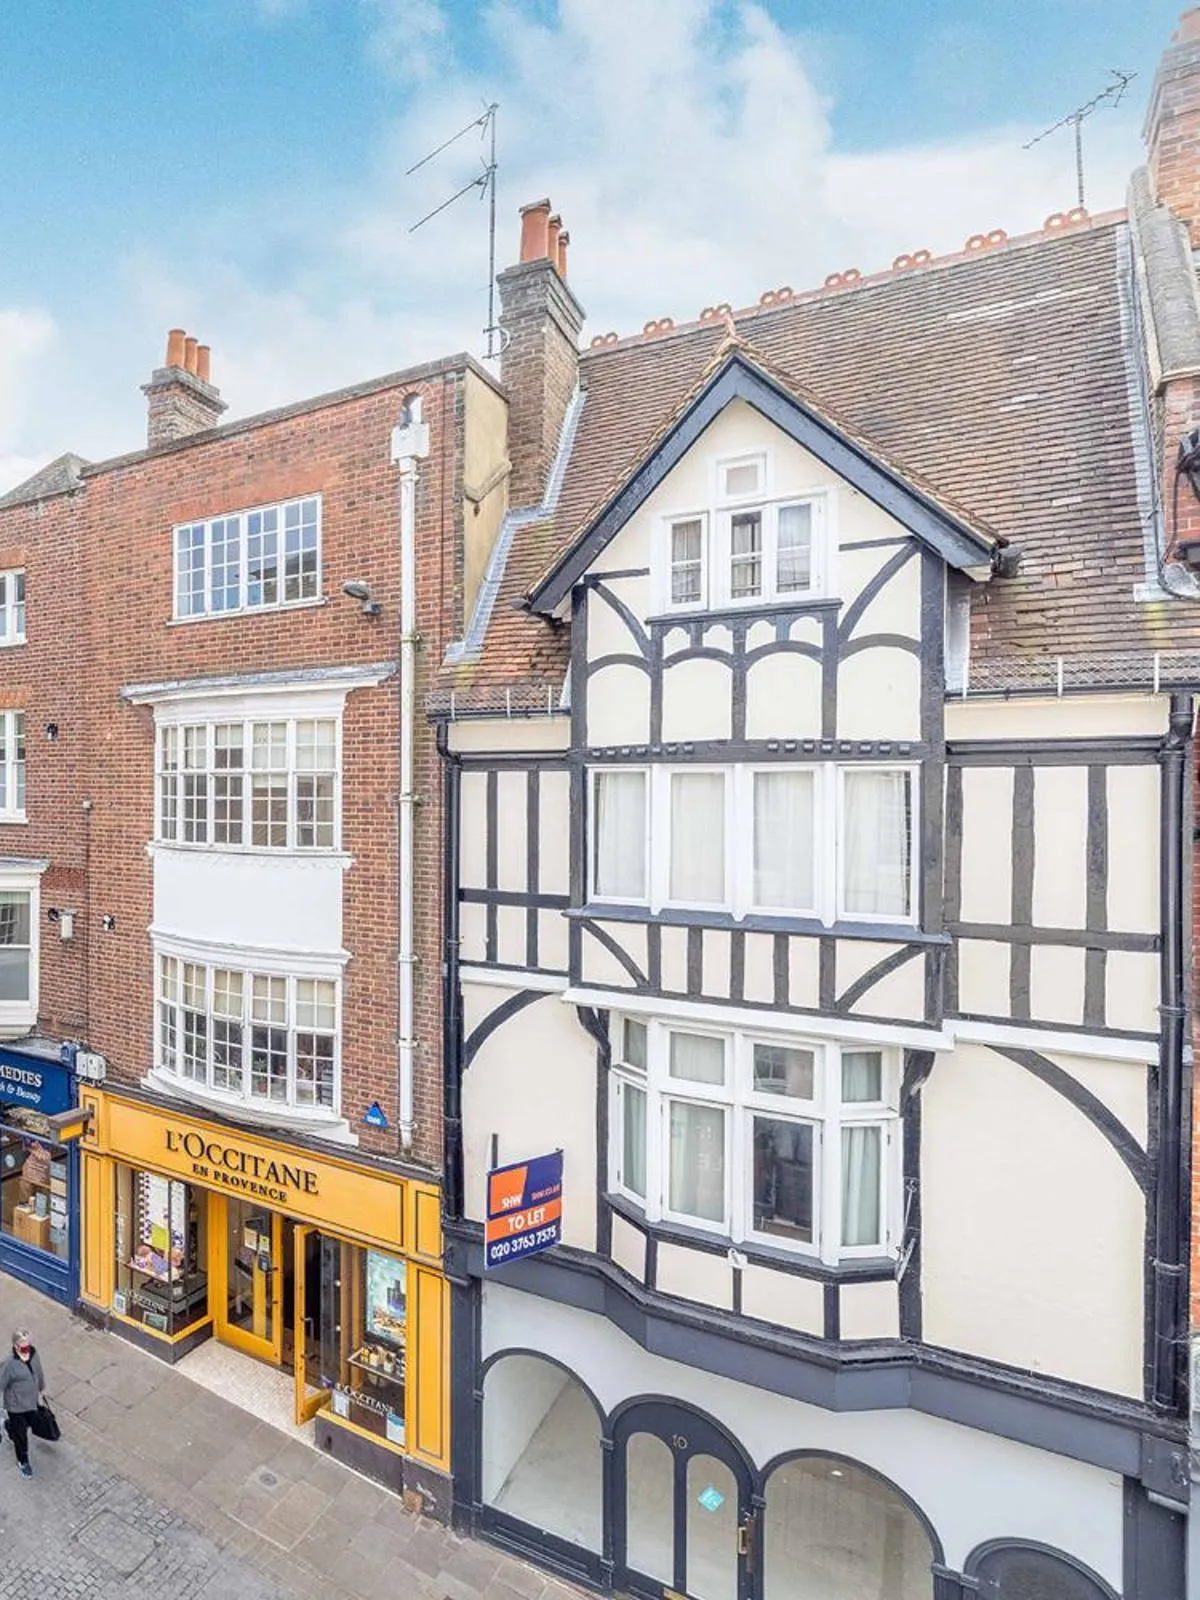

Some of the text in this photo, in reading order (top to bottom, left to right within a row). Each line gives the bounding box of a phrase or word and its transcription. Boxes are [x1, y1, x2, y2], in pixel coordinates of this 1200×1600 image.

[165, 1129, 319, 1195] L'OCCITANE
[192, 1163, 287, 1202] EN PROVENCE
[508, 1208, 546, 1232] TO LET
[490, 1225, 557, 1259] 020 3763 7575
[672, 1434, 688, 1450] 10
